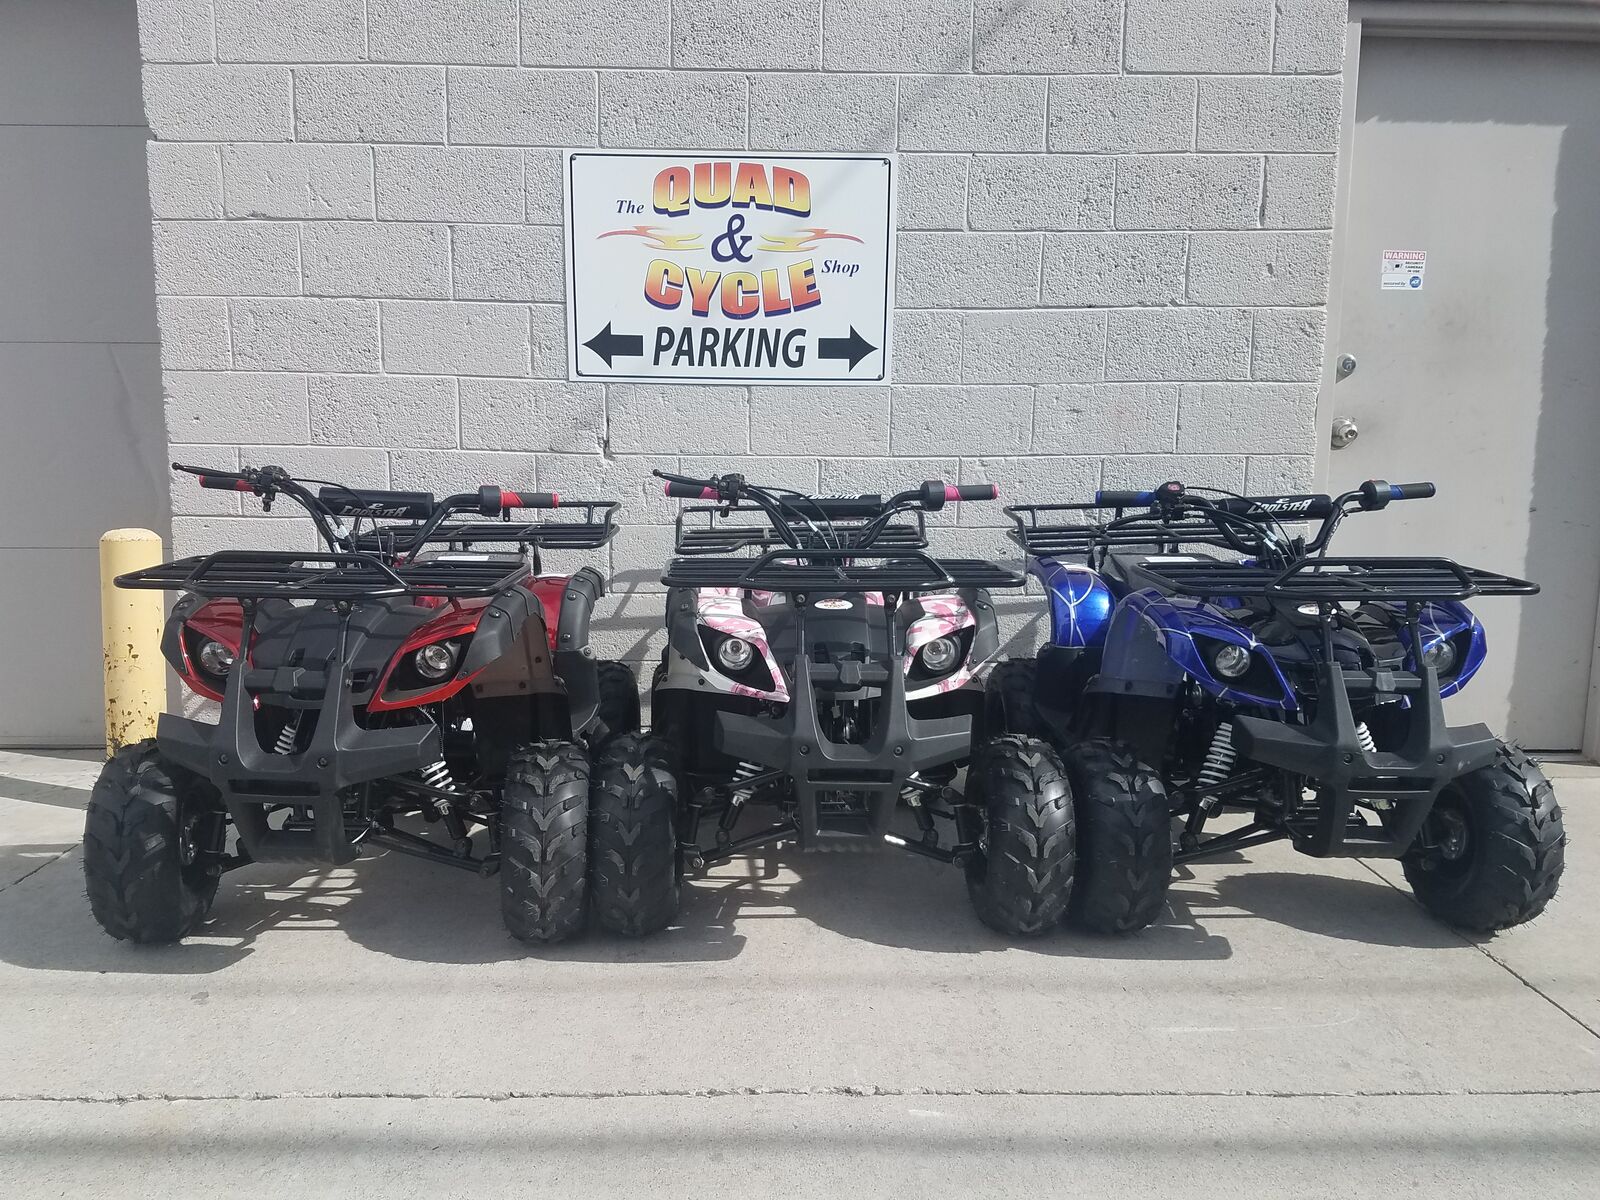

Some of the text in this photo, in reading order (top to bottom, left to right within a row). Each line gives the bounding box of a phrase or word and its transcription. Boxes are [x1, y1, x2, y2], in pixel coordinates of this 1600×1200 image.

[616, 162, 812, 218] The QUAD
[711, 213, 753, 263] &
[1385, 251, 1424, 260] WARNING
[644, 258, 860, 320] CYCLE Shop
[653, 326, 807, 368] PARKING
[1246, 499, 1313, 514] COOLSTER
